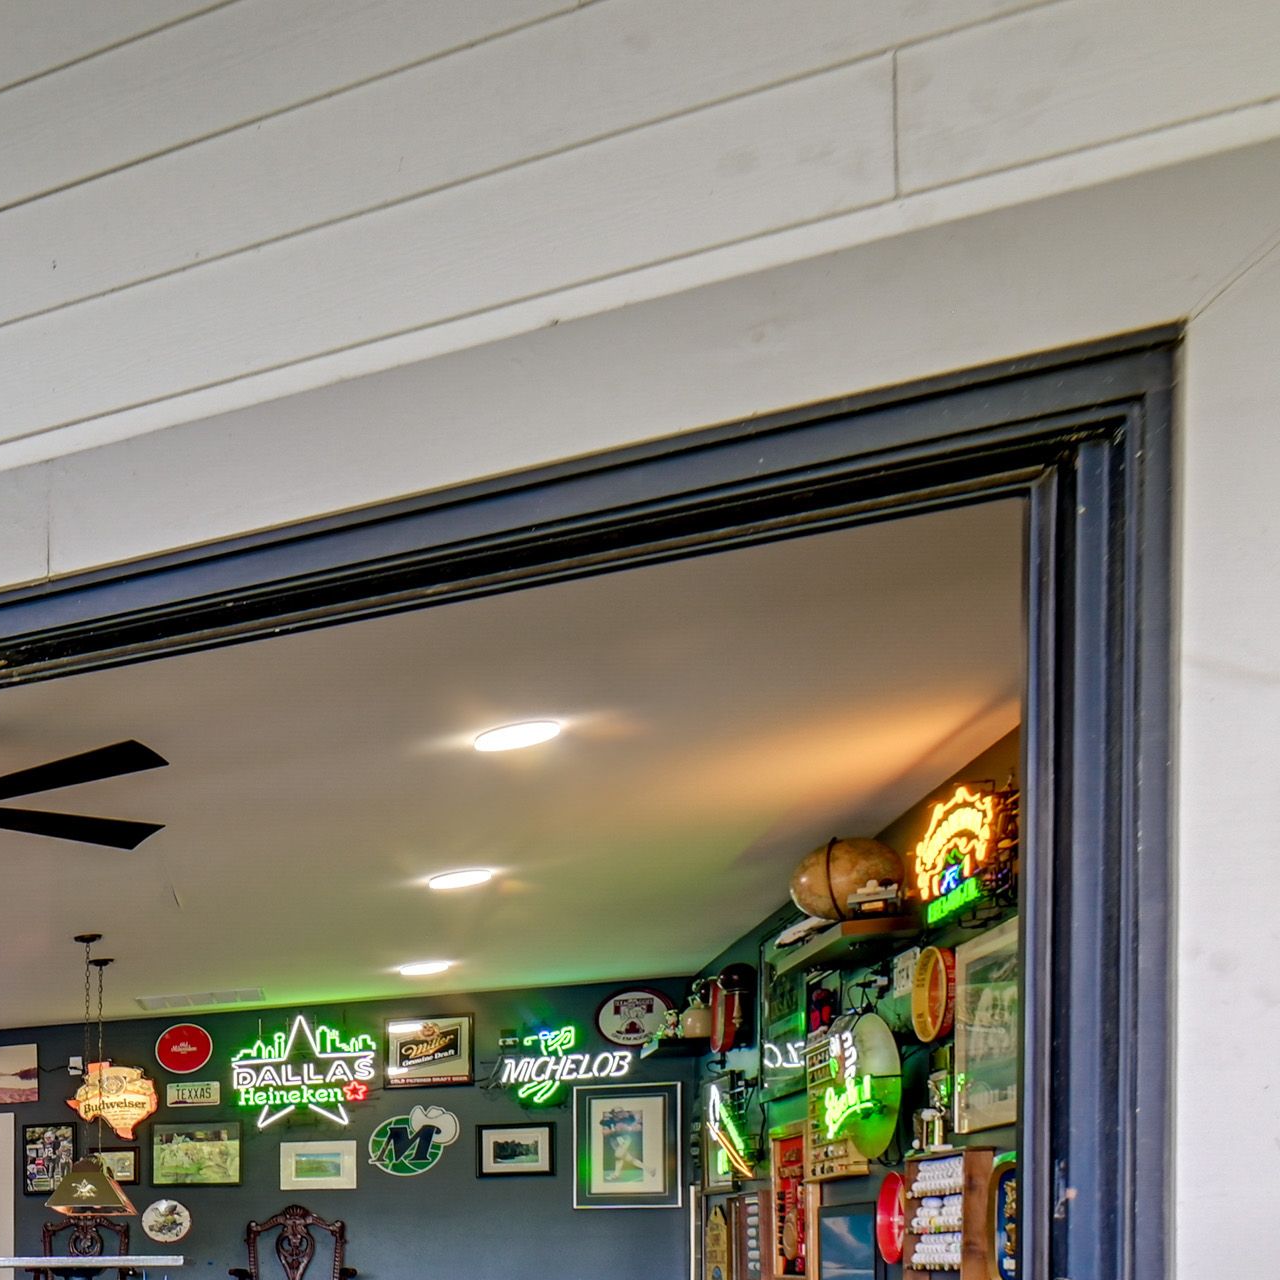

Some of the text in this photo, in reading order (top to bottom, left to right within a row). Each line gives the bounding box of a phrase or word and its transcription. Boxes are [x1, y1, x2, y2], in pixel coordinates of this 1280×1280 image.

[401, 1034, 455, 1059] Miller
[402, 1049, 456, 1067] Genuine Draft
[501, 1051, 632, 1083] MICHELOB
[233, 1058, 375, 1089] DALLAS
[176, 1087, 212, 1100] TEXXAS
[238, 1085, 344, 1105] Heineken
[84, 1098, 147, 1114] Budweiser
